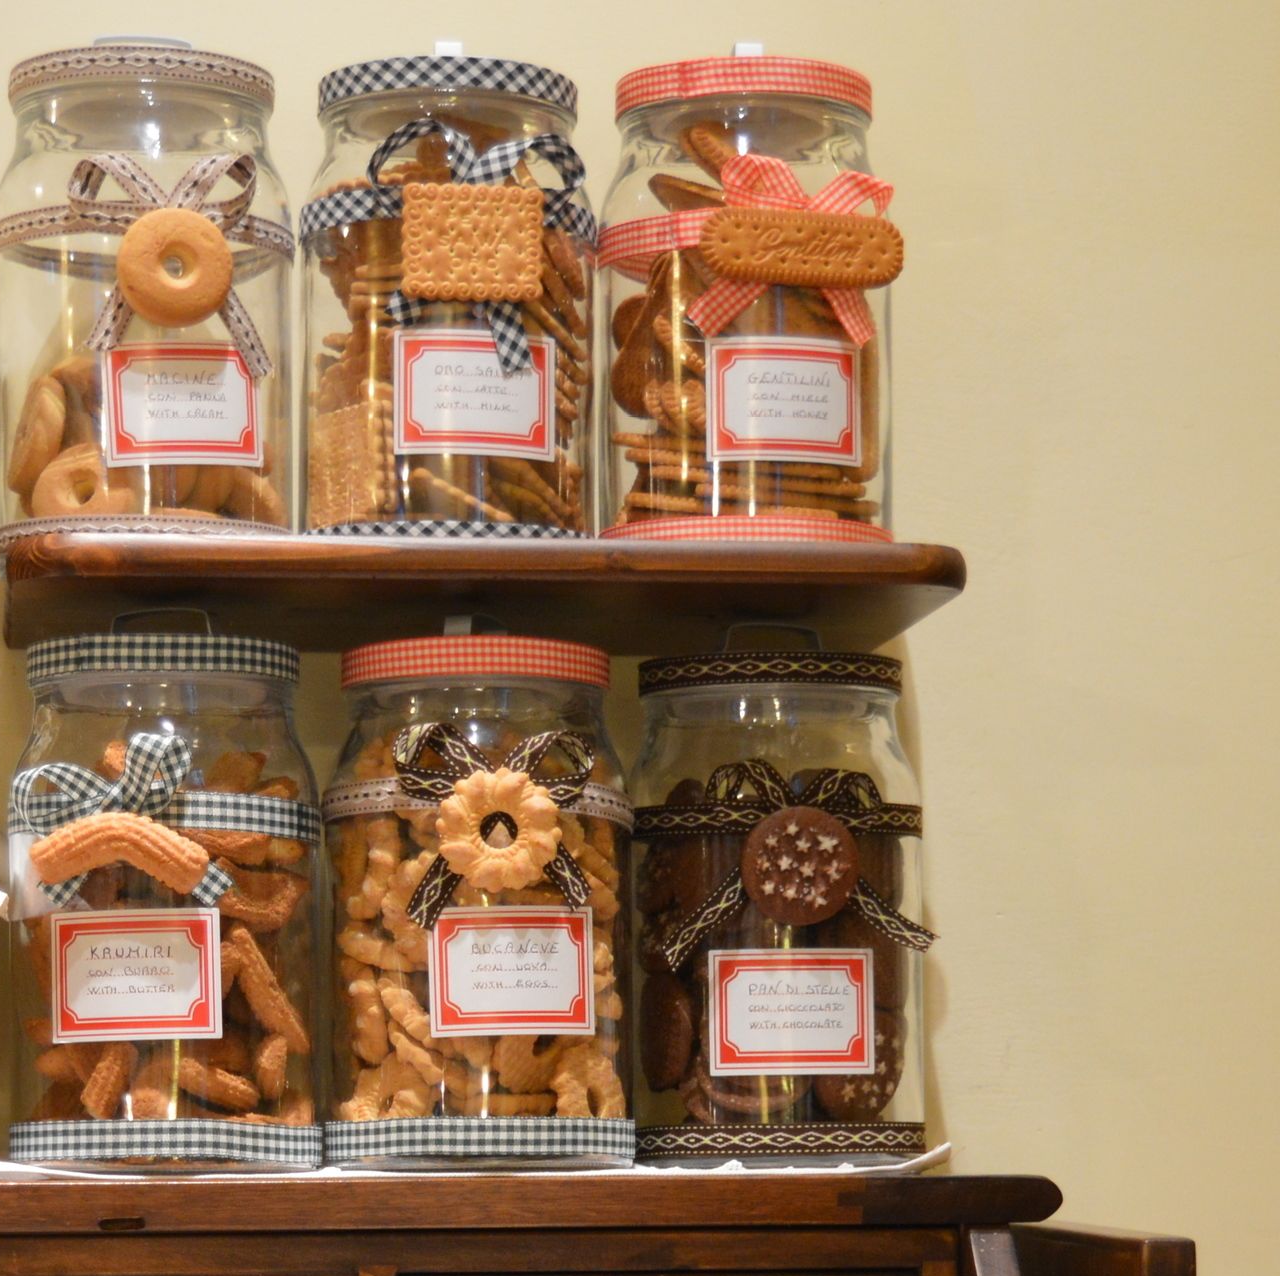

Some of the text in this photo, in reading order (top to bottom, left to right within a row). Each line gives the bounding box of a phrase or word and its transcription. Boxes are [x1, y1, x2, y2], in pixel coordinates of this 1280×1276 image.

[146, 370, 218, 386] MACINE
[434, 364, 465, 377] ORO
[746, 371, 831, 388] GENTILINI
[189, 391, 227, 402] PANNA
[471, 939, 560, 955] BUCANEVE
[128, 983, 176, 994] BUTTER
[748, 980, 851, 996] PAN DI STELLE
